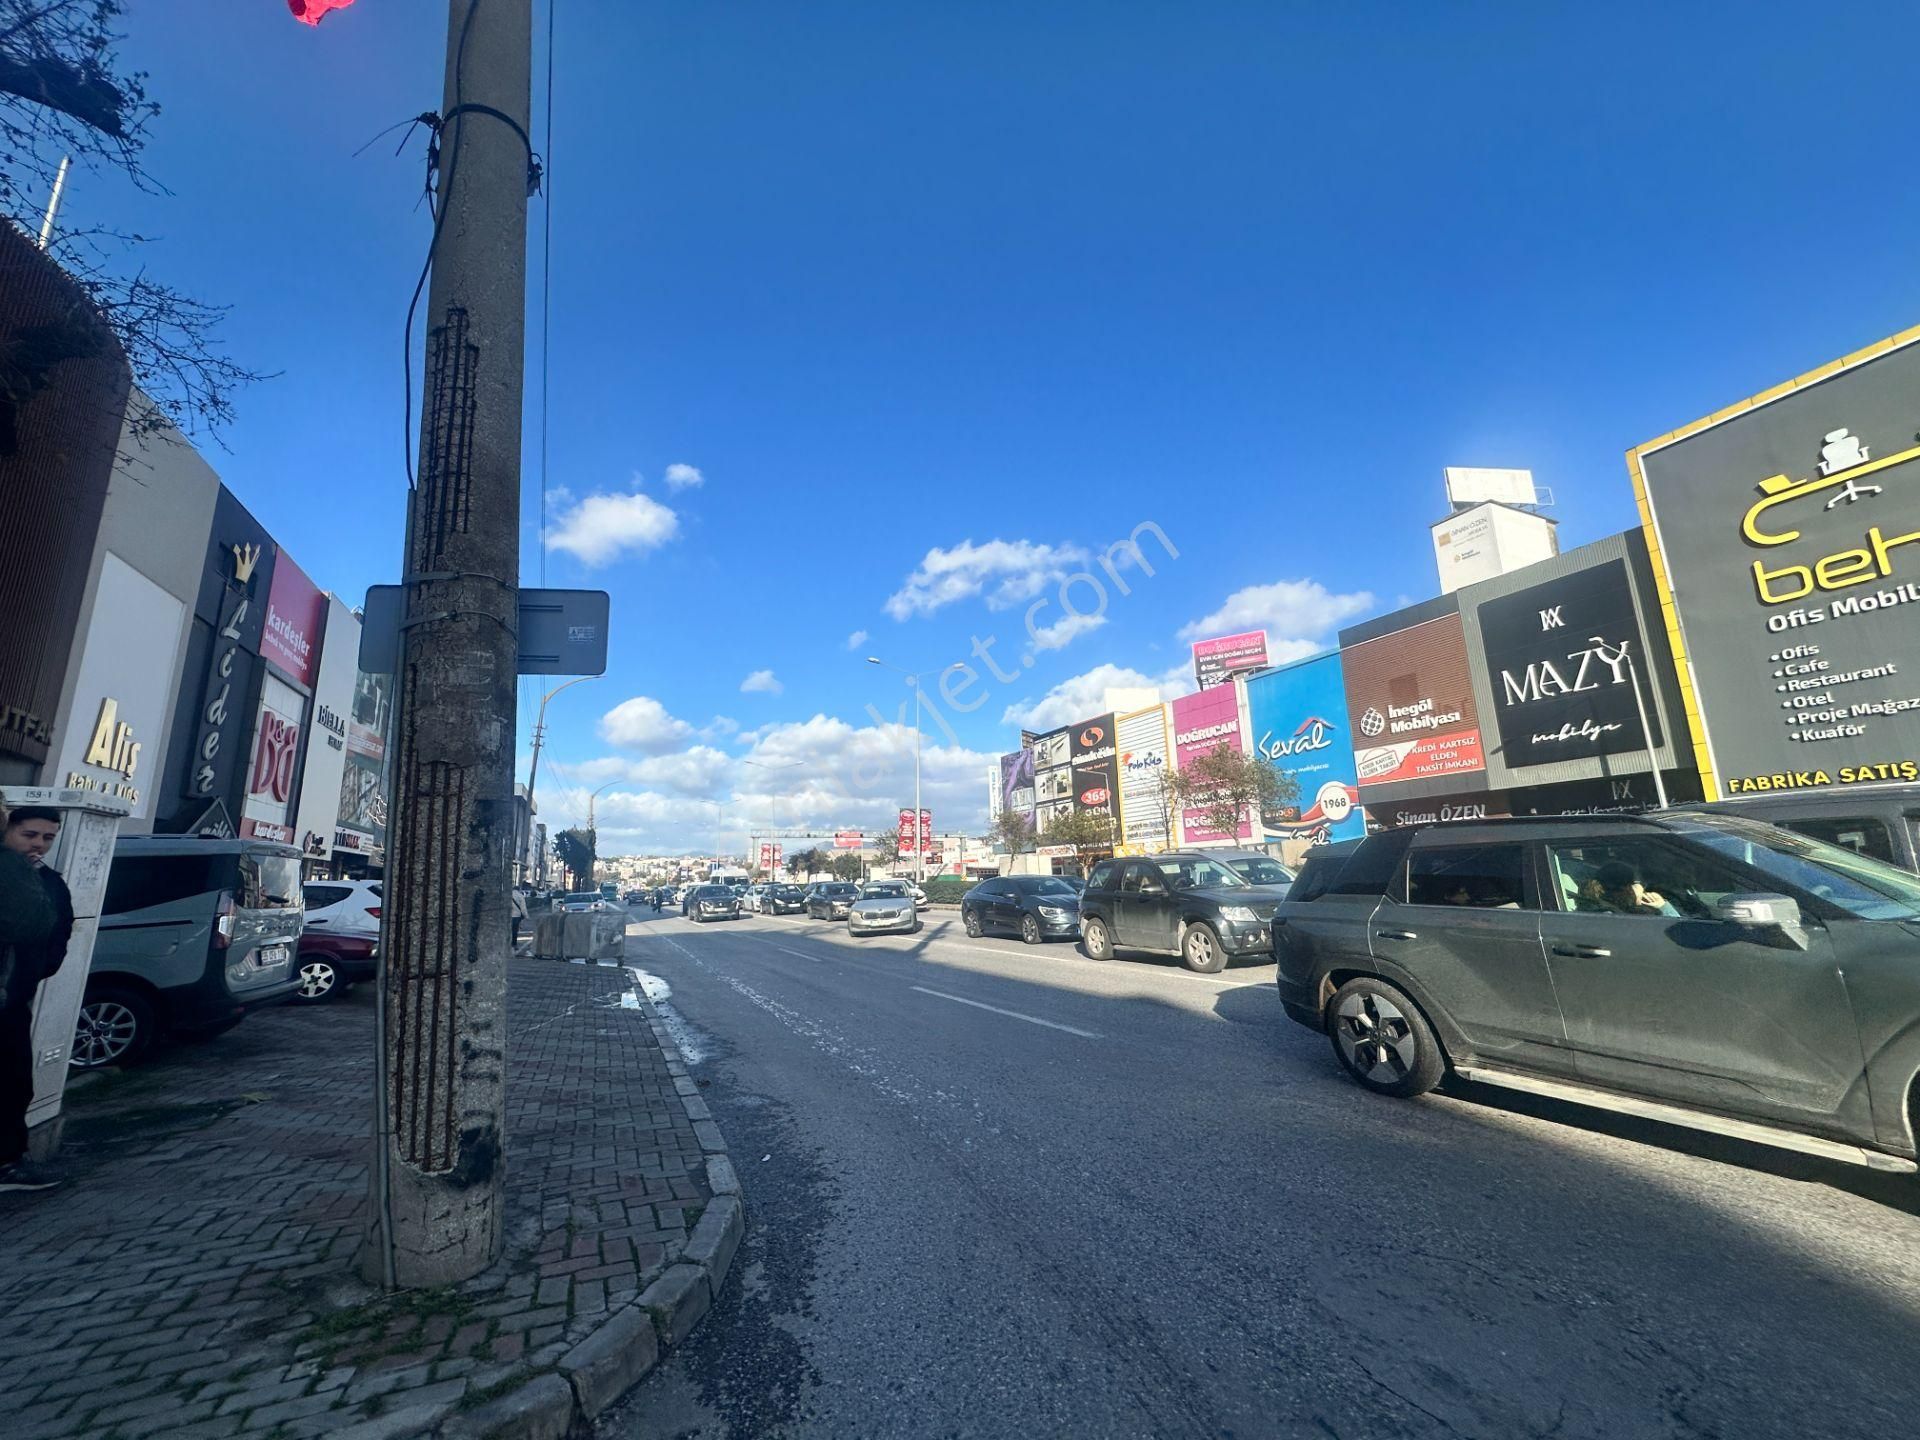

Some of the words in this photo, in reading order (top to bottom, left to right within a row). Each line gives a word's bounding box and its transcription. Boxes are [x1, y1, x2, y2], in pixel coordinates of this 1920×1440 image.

[1768, 608, 1825, 632] Ofis
[1781, 645, 1820, 660] Ofis
[1501, 640, 1630, 706] MAZY
[1785, 660, 1829, 675] Cafe
[1788, 663, 1897, 691] Restaurant
[197, 600, 248, 792] Lider
[1793, 691, 1835, 708] Otel
[1388, 698, 1432, 718] İnegöl
[1797, 708, 1849, 724] Proje
[1176, 720, 1238, 745] DOĞRUCAN
[1390, 712, 1460, 733] Mobilyası
[1532, 719, 1622, 744] mobilya
[1802, 724, 1866, 741] Kuaför
[84, 697, 142, 782] Aliş
[1259, 722, 1331, 760] Seval
[1412, 743, 1436, 754] KREDİ
[1440, 737, 1475, 750] KARTSIZ
[1431, 752, 1457, 761] ELDEN
[1416, 763, 1444, 774] TAKSİT
[1729, 770, 1831, 793] FABRİKA
[1839, 761, 1918, 782] SATIŞ
[1085, 789, 1105, 803] 365
[1324, 797, 1347, 809] 1968
[1396, 811, 1436, 825] Sinan
[1441, 803, 1485, 821] ÖZEN
